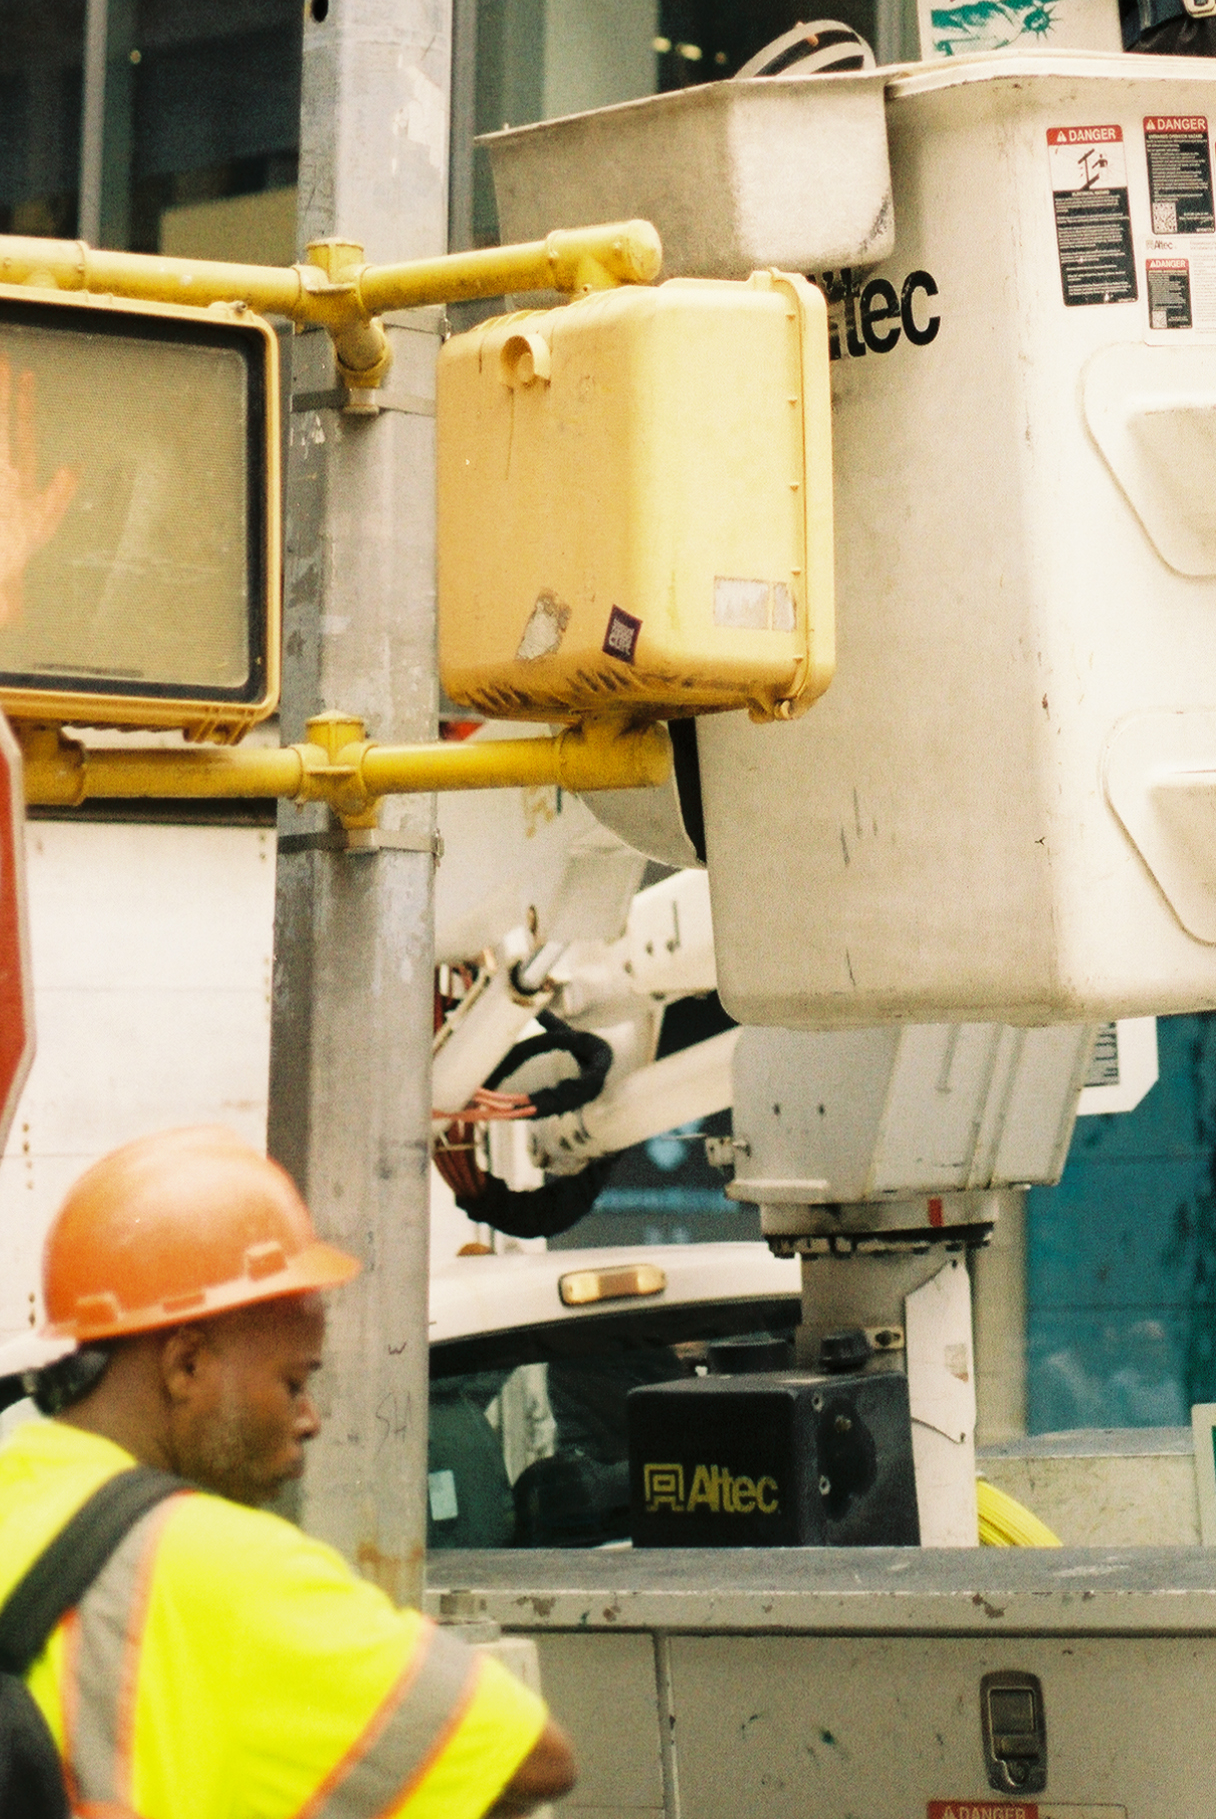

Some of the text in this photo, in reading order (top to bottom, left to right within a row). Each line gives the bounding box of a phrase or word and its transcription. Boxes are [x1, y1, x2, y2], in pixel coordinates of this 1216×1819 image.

[1157, 118, 1207, 131] DANGER
[1068, 128, 1117, 142] DANGER
[1154, 239, 1174, 251] Altec
[1156, 259, 1187, 268] DANGER
[687, 1462, 780, 1515] Altec
[958, 1806, 1026, 1819] DANGER
